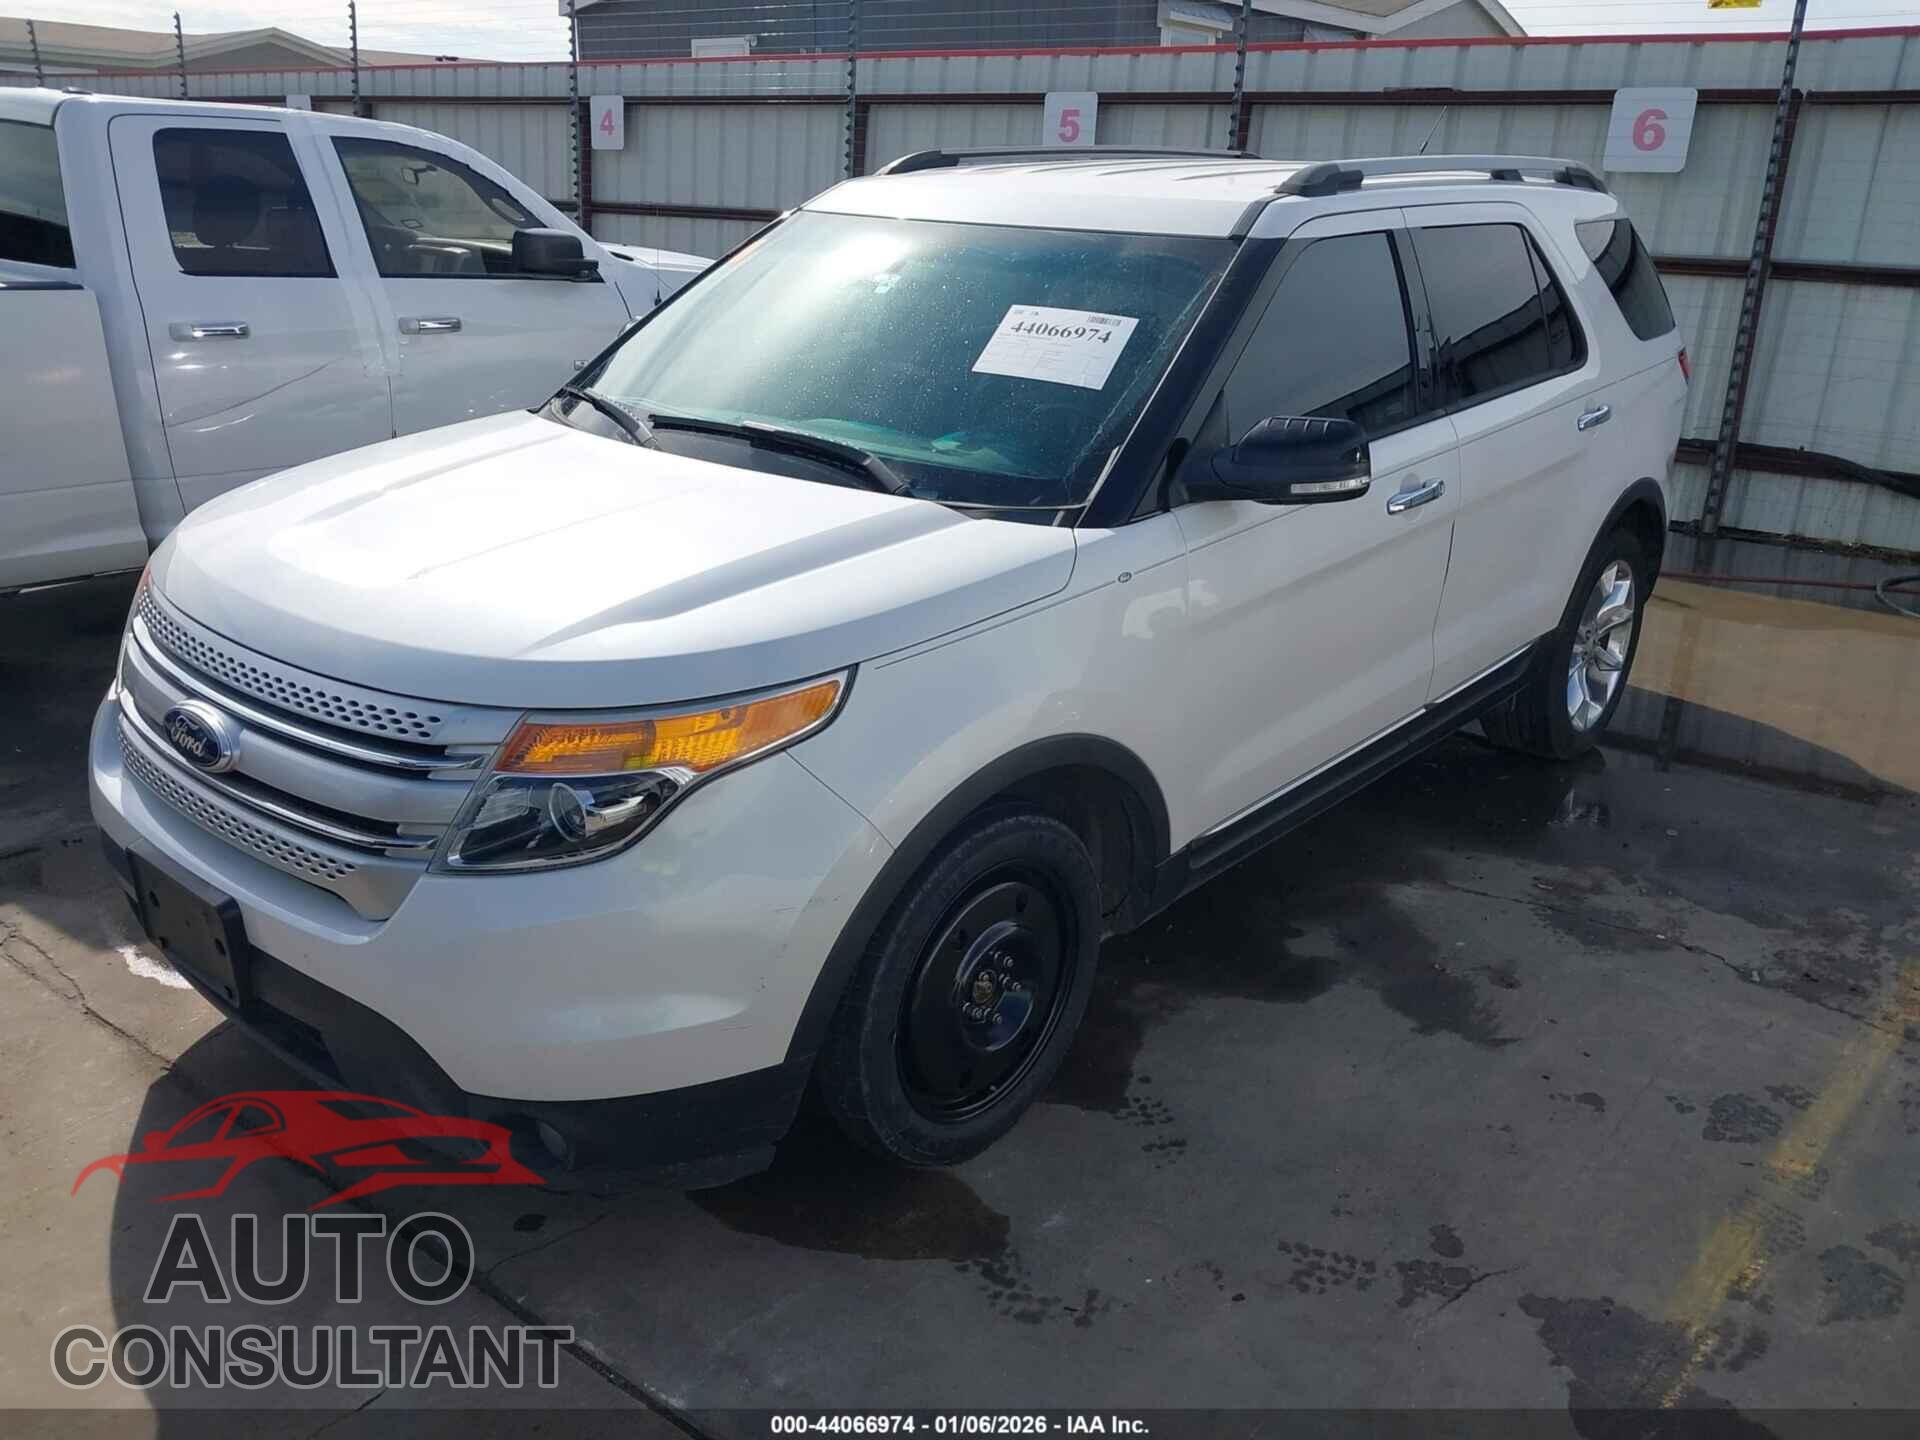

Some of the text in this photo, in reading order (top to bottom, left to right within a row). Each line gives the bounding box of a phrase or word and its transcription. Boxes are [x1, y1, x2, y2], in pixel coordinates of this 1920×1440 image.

[599, 109, 614, 136] 4
[1059, 109, 1080, 143] 5
[1633, 109, 1667, 151] 6
[1011, 321, 1112, 343] 44066974
[171, 715, 207, 757] Ford
